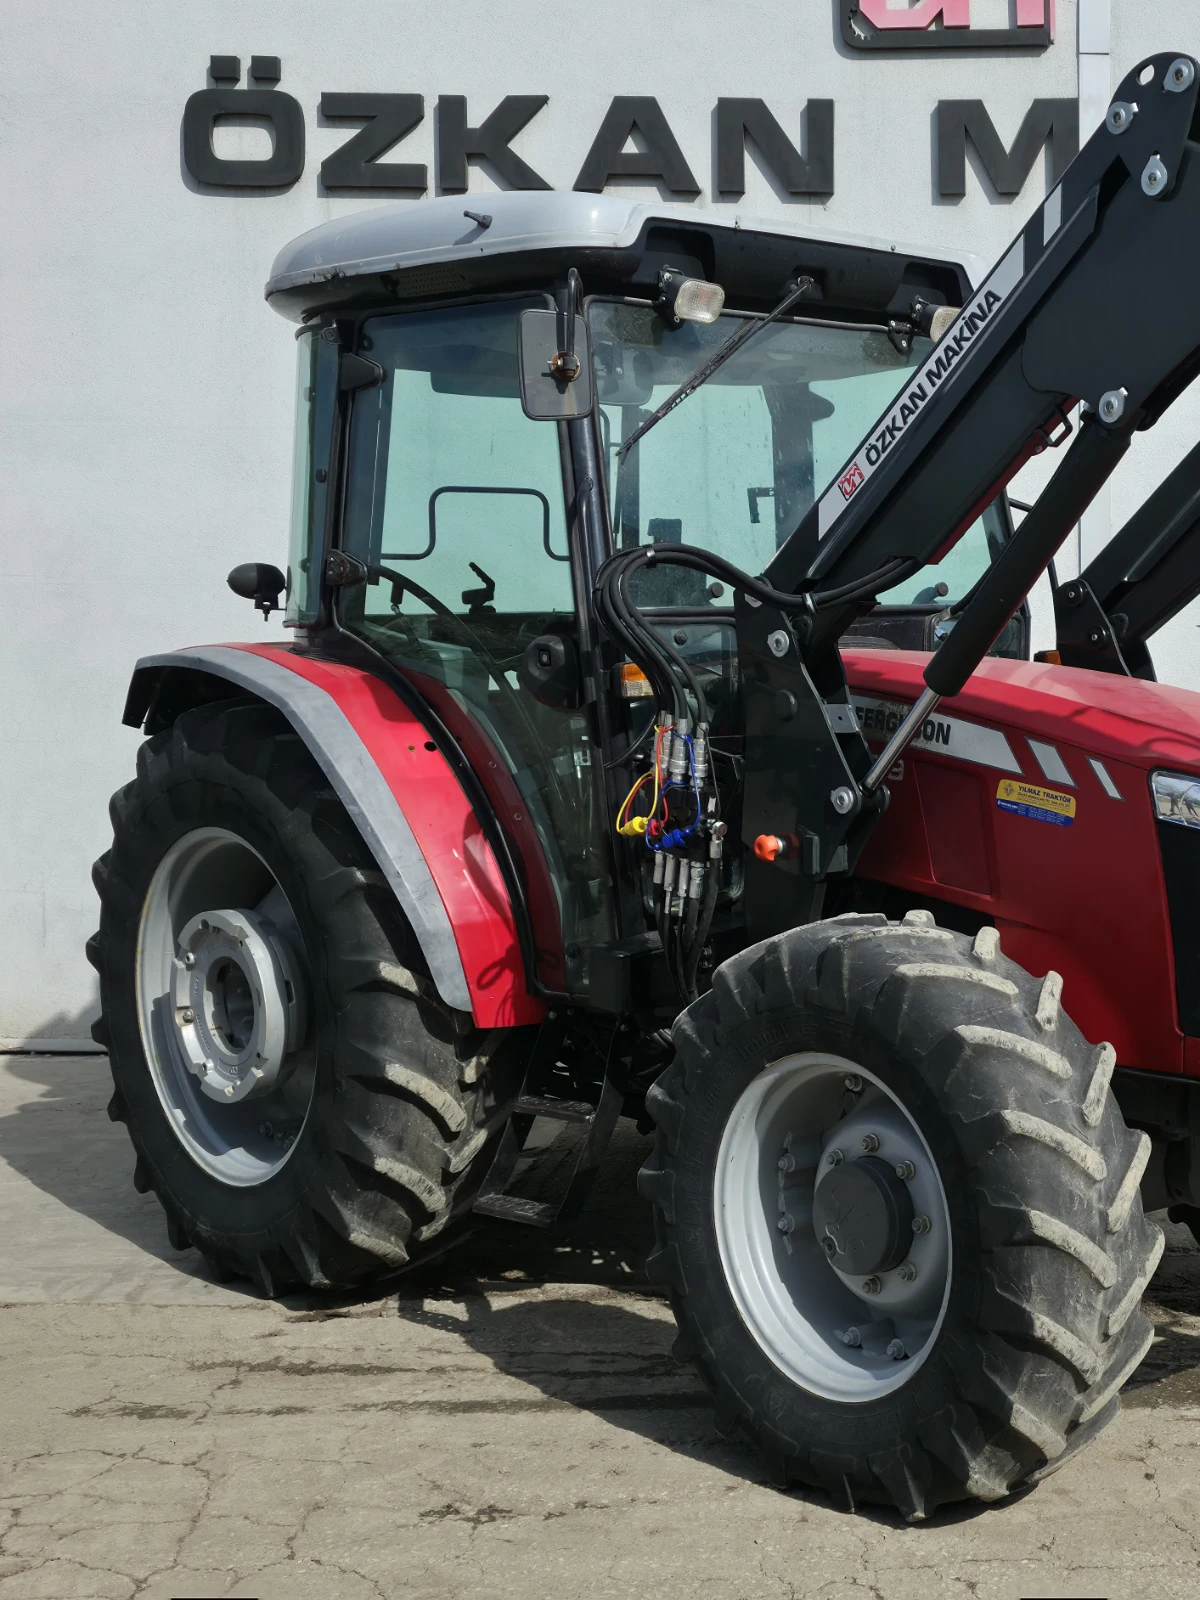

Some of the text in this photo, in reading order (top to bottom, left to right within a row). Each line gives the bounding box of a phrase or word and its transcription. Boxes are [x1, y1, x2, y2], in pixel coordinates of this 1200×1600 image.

[183, 55, 835, 197] ÖZKAN
[864, 289, 1003, 467] ÖZKAN MAKİNA
[856, 706, 951, 746] FERGON
[1018, 785, 1042, 796] YILMAZ
